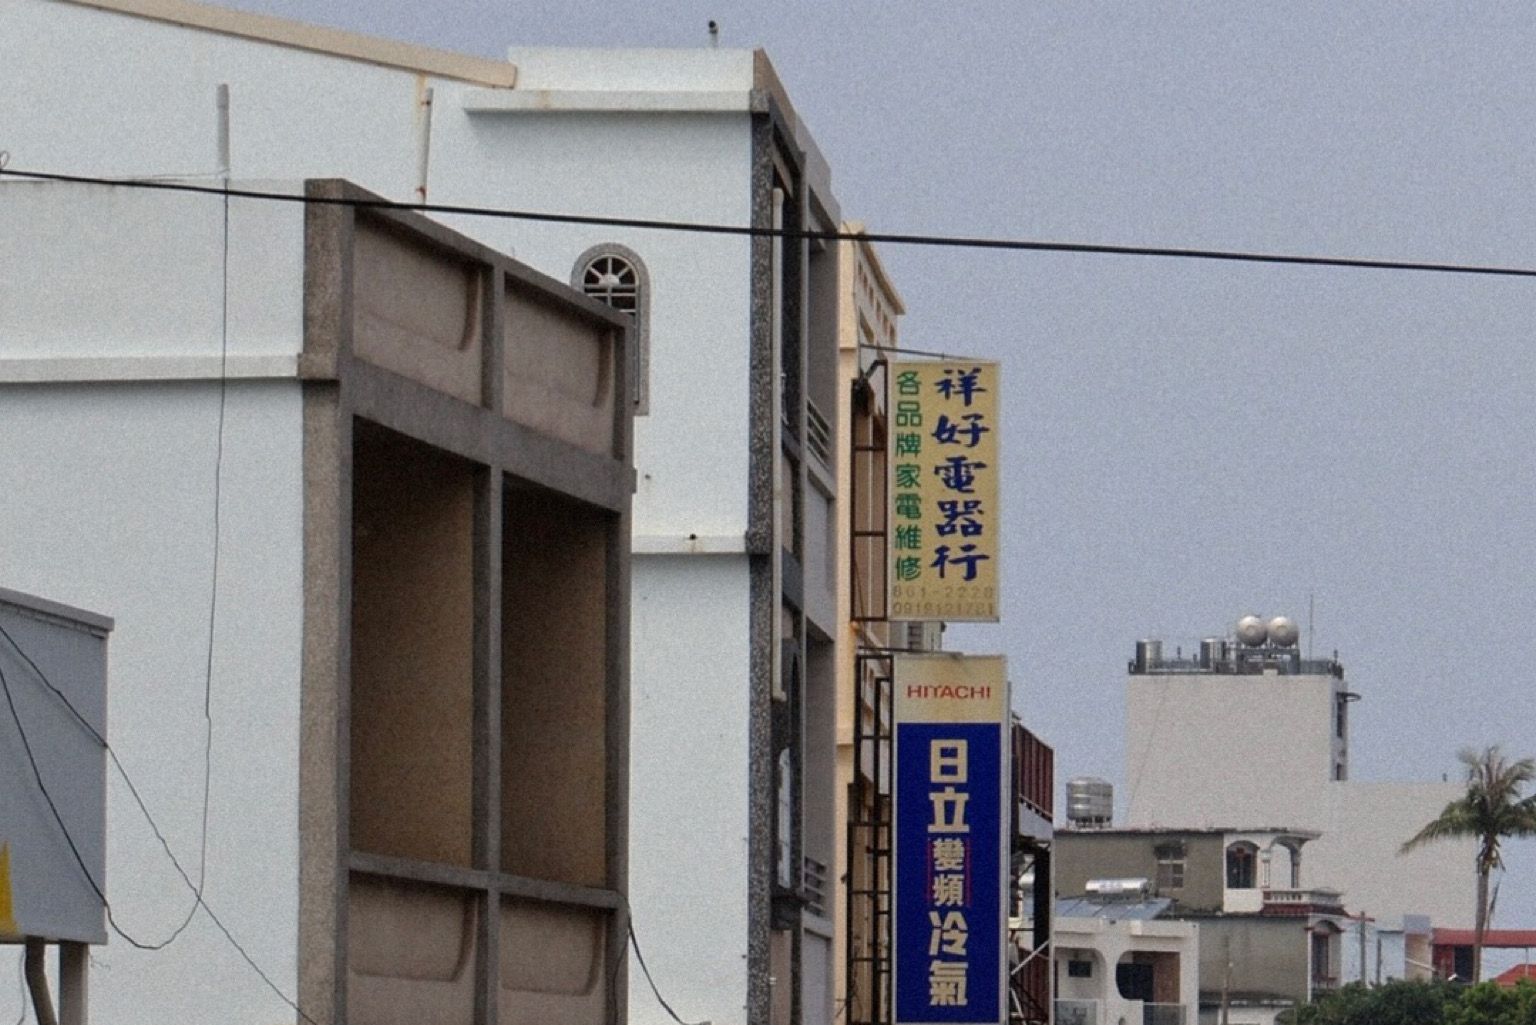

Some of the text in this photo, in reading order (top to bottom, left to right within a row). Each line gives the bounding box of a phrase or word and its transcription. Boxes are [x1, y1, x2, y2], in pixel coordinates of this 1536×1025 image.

[895, 370, 922, 582] 各品牌家電維修
[931, 367, 990, 582] 祥好電器行
[907, 685, 991, 700] HITACHI
